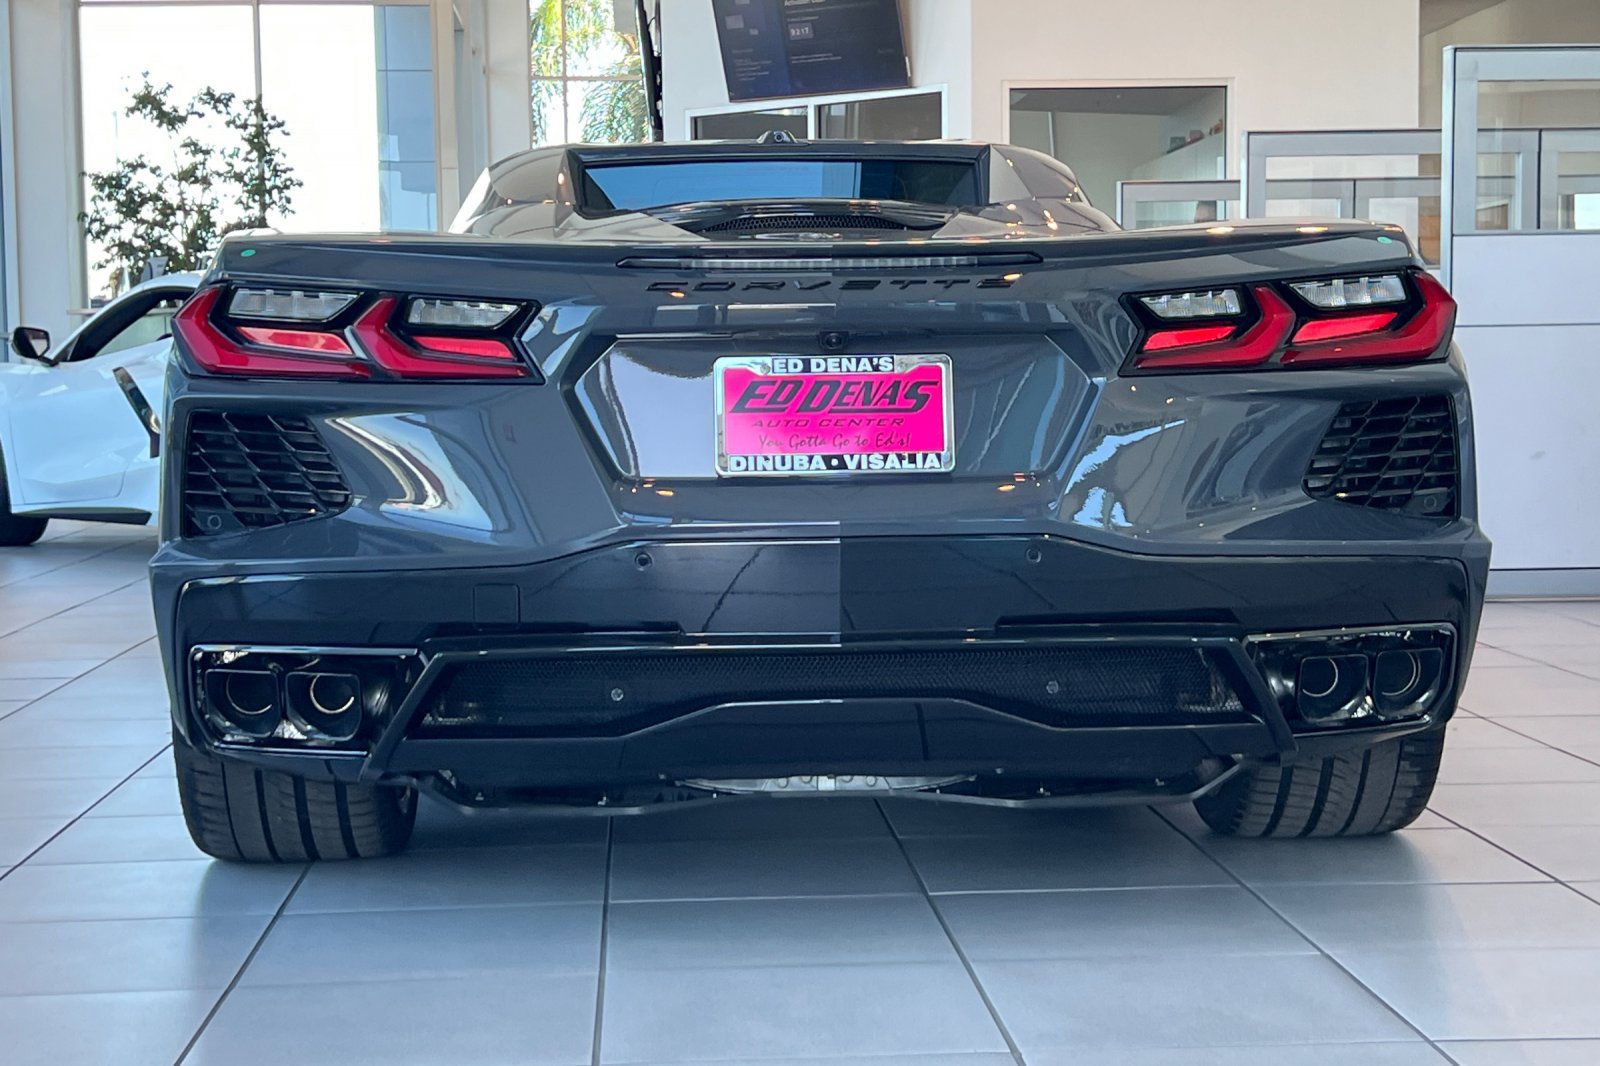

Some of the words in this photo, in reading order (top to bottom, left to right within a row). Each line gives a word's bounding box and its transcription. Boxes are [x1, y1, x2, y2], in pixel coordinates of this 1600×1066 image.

[645, 279, 1015, 291] CORVETTE
[773, 358, 804, 373] ED
[810, 357, 893, 372] DENA'S
[729, 380, 799, 413] ED
[752, 418, 809, 427] AUTO
[818, 418, 905, 427] CENTER
[759, 434, 783, 448] You
[789, 433, 826, 449] Gotta
[832, 433, 850, 448] Go
[855, 435, 868, 446] to
[875, 432, 912, 448] Ed's!
[731, 454, 827, 471] DINUBA
[843, 452, 942, 469] VISALIA
